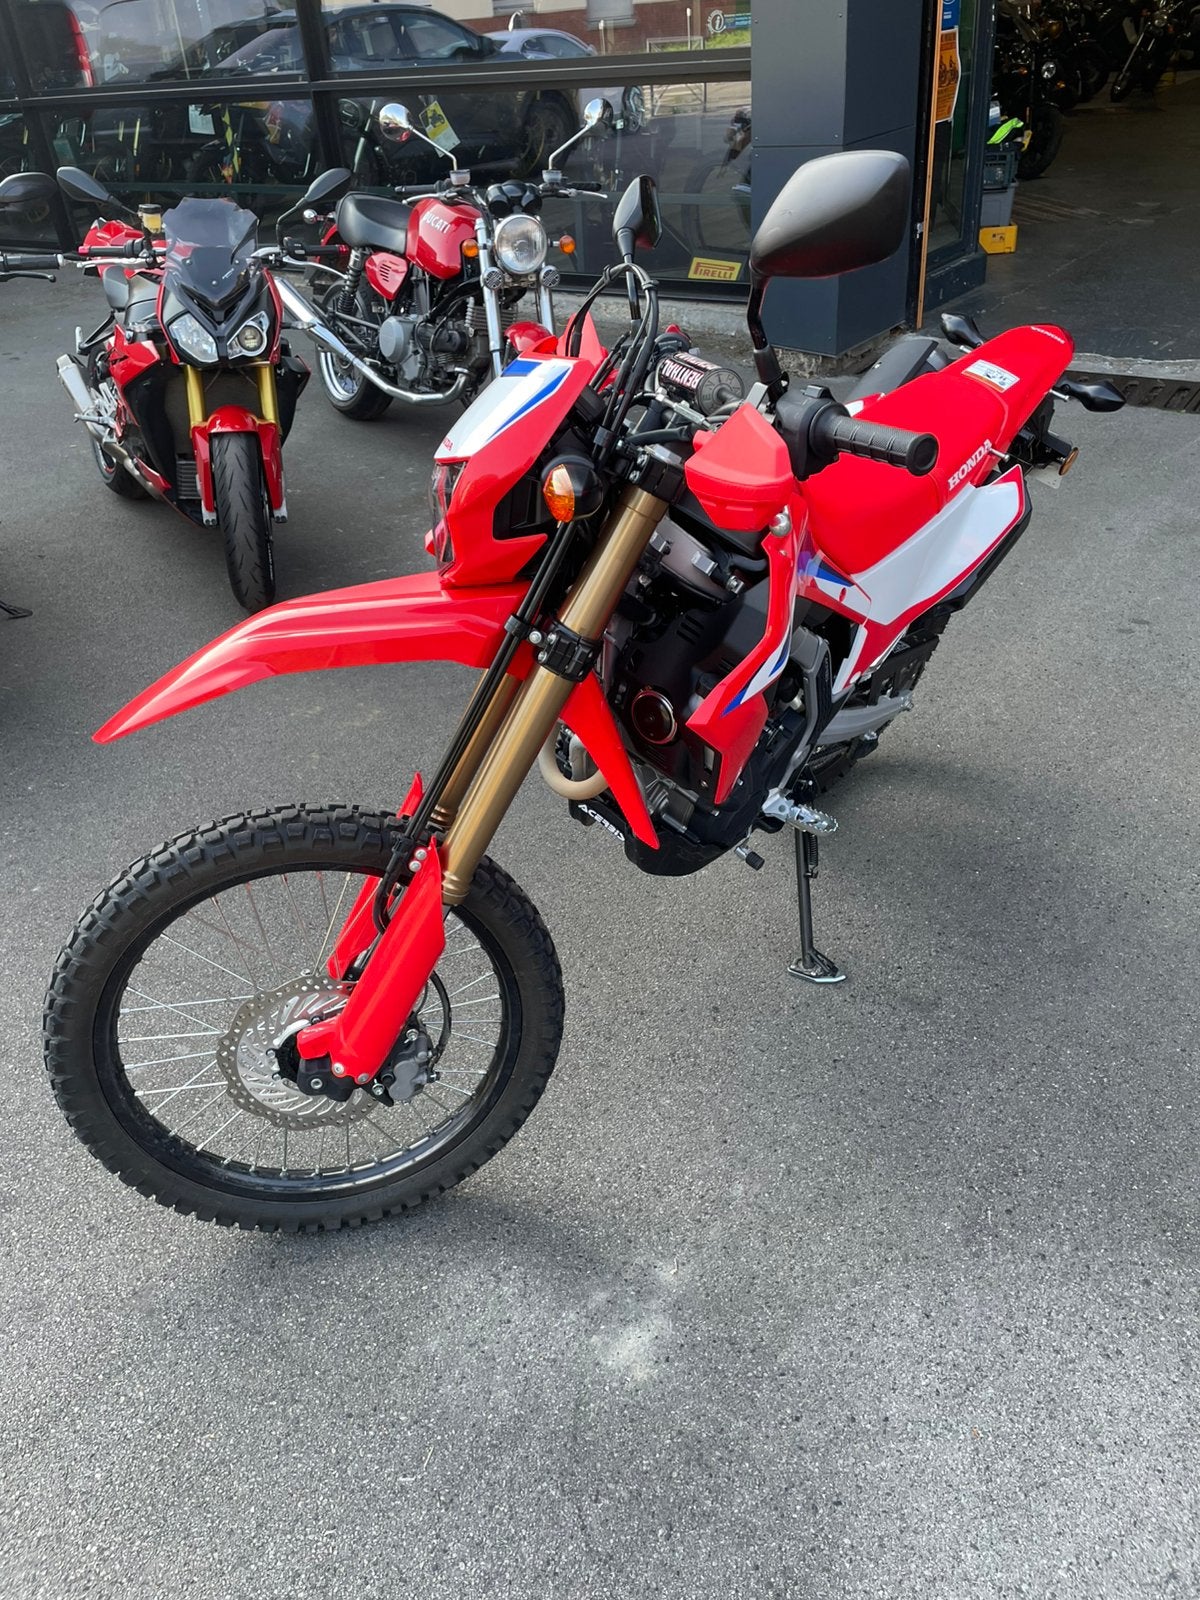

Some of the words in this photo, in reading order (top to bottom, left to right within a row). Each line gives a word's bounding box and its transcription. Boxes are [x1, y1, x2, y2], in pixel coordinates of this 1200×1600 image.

[422, 211, 451, 234] DUCATI
[694, 261, 736, 279] PIRELLI
[662, 359, 704, 389] RENTHAL
[948, 439, 992, 491] HONDA
